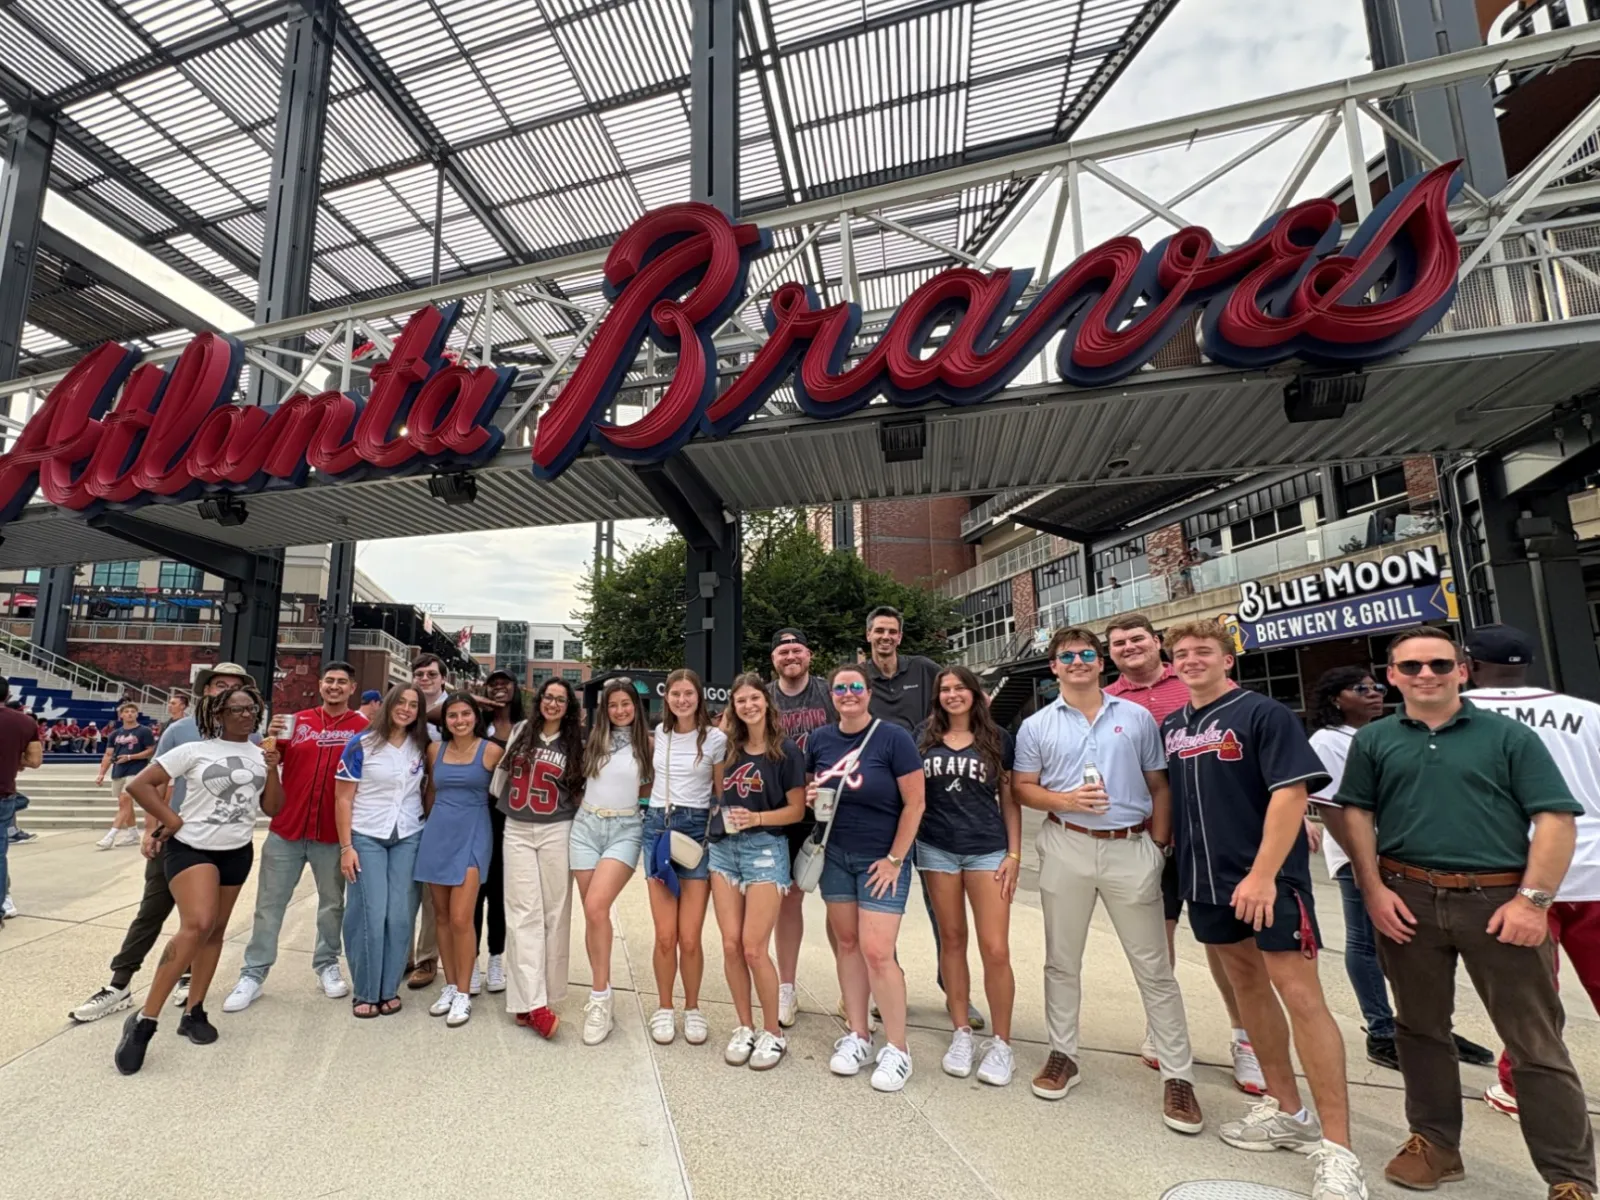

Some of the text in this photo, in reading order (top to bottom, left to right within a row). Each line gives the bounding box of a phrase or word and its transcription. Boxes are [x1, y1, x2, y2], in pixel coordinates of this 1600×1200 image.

[0, 158, 1464, 526] Atlanta Braves
[1238, 546, 1438, 623] BLUE MOON
[1255, 595, 1422, 643] BREWERY & GRILL
[508, 755, 560, 815] 95
[923, 756, 987, 783] BRAVES
